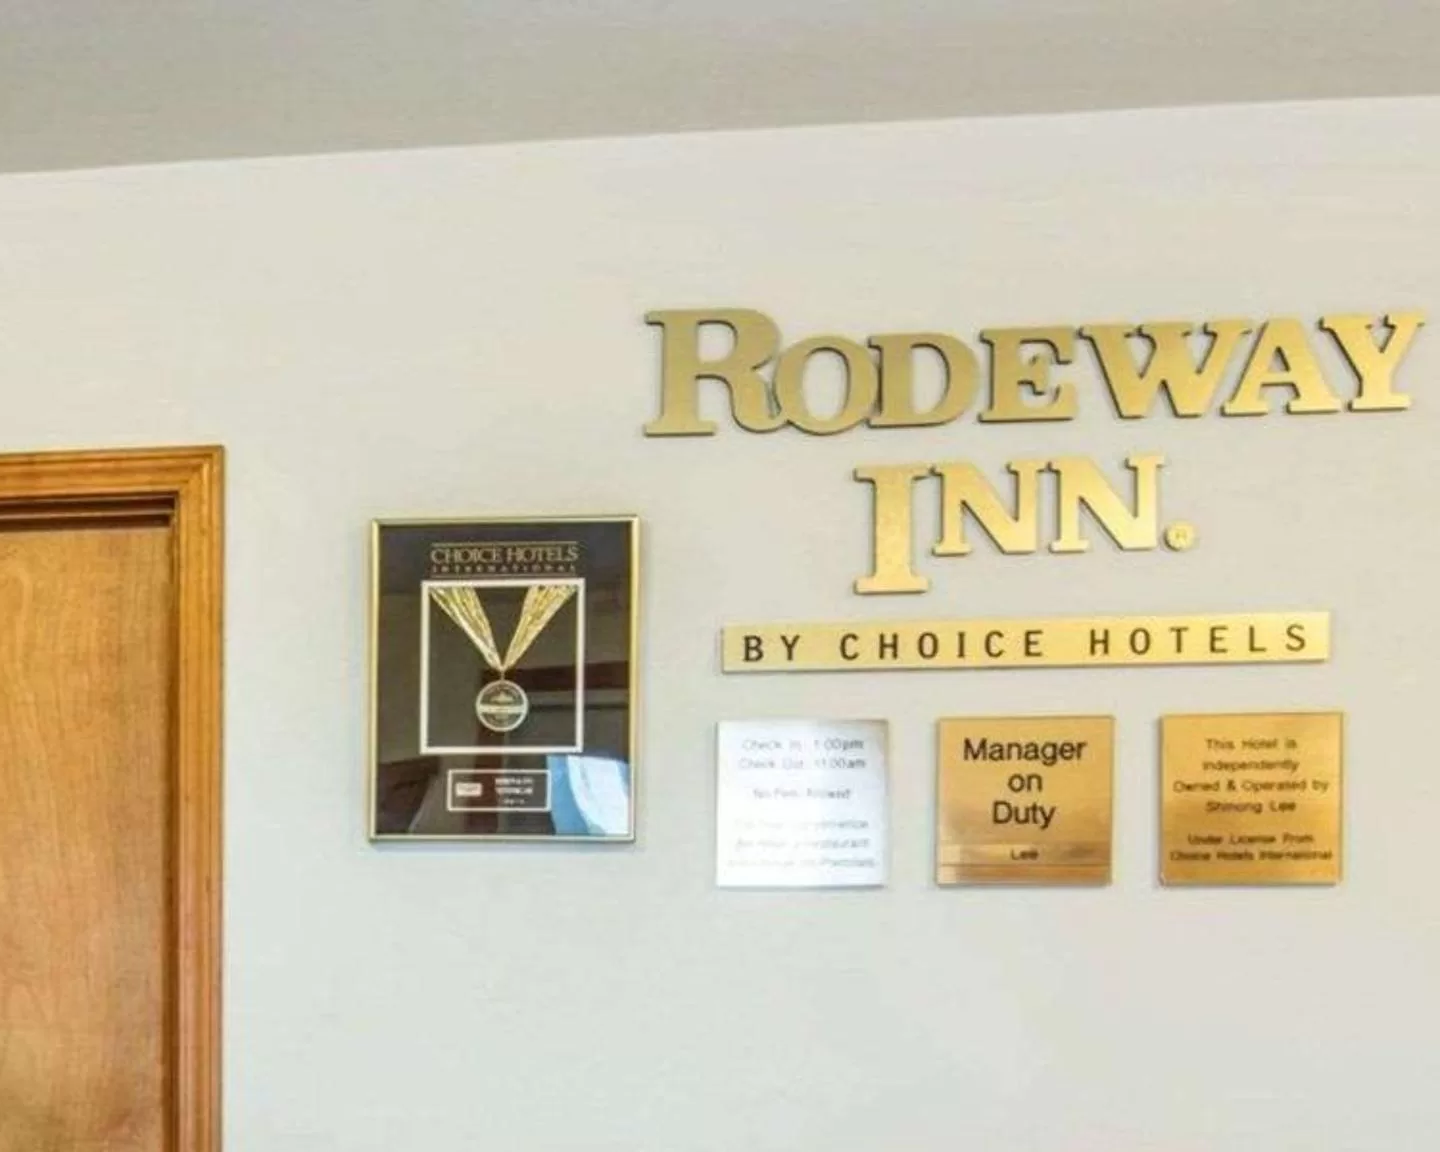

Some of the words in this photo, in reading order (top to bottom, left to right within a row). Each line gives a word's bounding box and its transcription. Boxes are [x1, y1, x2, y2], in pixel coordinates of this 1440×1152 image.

[643, 308, 1424, 437] RODEWAY
[431, 547, 502, 564] CHOICE
[506, 546, 578, 563] HOTELS
[743, 634, 800, 663] BY
[840, 629, 1044, 660] CHOICE
[1089, 623, 1307, 656] HOTELS
[963, 737, 1087, 766] Manager
[1206, 738, 1235, 750] This
[1241, 738, 1277, 750] Hotel
[1008, 772, 1043, 793] on
[1241, 780, 1306, 793] Operated
[992, 800, 1057, 830] Duty
[1268, 801, 1297, 813] Lee
[1011, 849, 1039, 860] Lee
